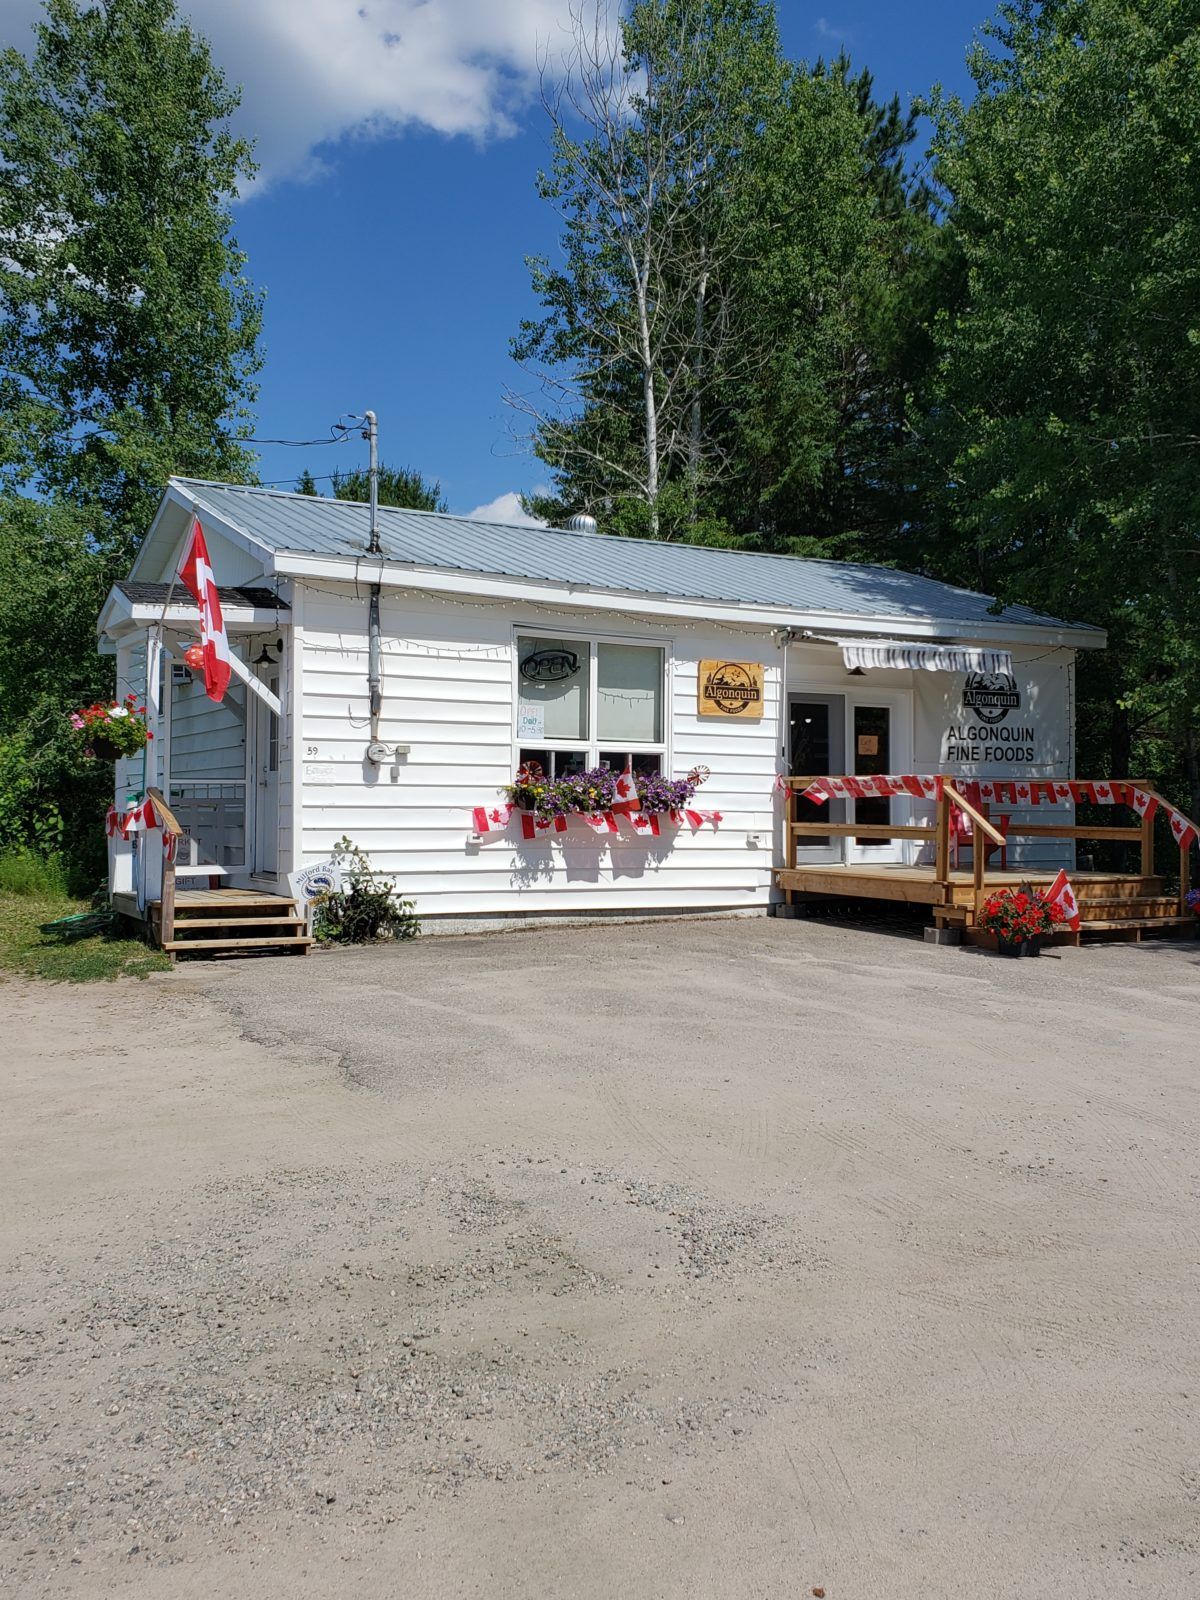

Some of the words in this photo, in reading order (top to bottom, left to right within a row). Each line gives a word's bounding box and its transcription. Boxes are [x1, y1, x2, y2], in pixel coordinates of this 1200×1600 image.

[524, 655, 578, 676] OPEN
[705, 686, 757, 700] Algonquin
[965, 690, 1017, 708] Algonquin
[947, 726, 1034, 742] ALGONQUIN
[306, 745, 319, 756] 59
[947, 746, 980, 761] FINE
[985, 746, 1034, 761] FOODS
[175, 876, 197, 885] GIFT
[295, 865, 320, 885] Milford
